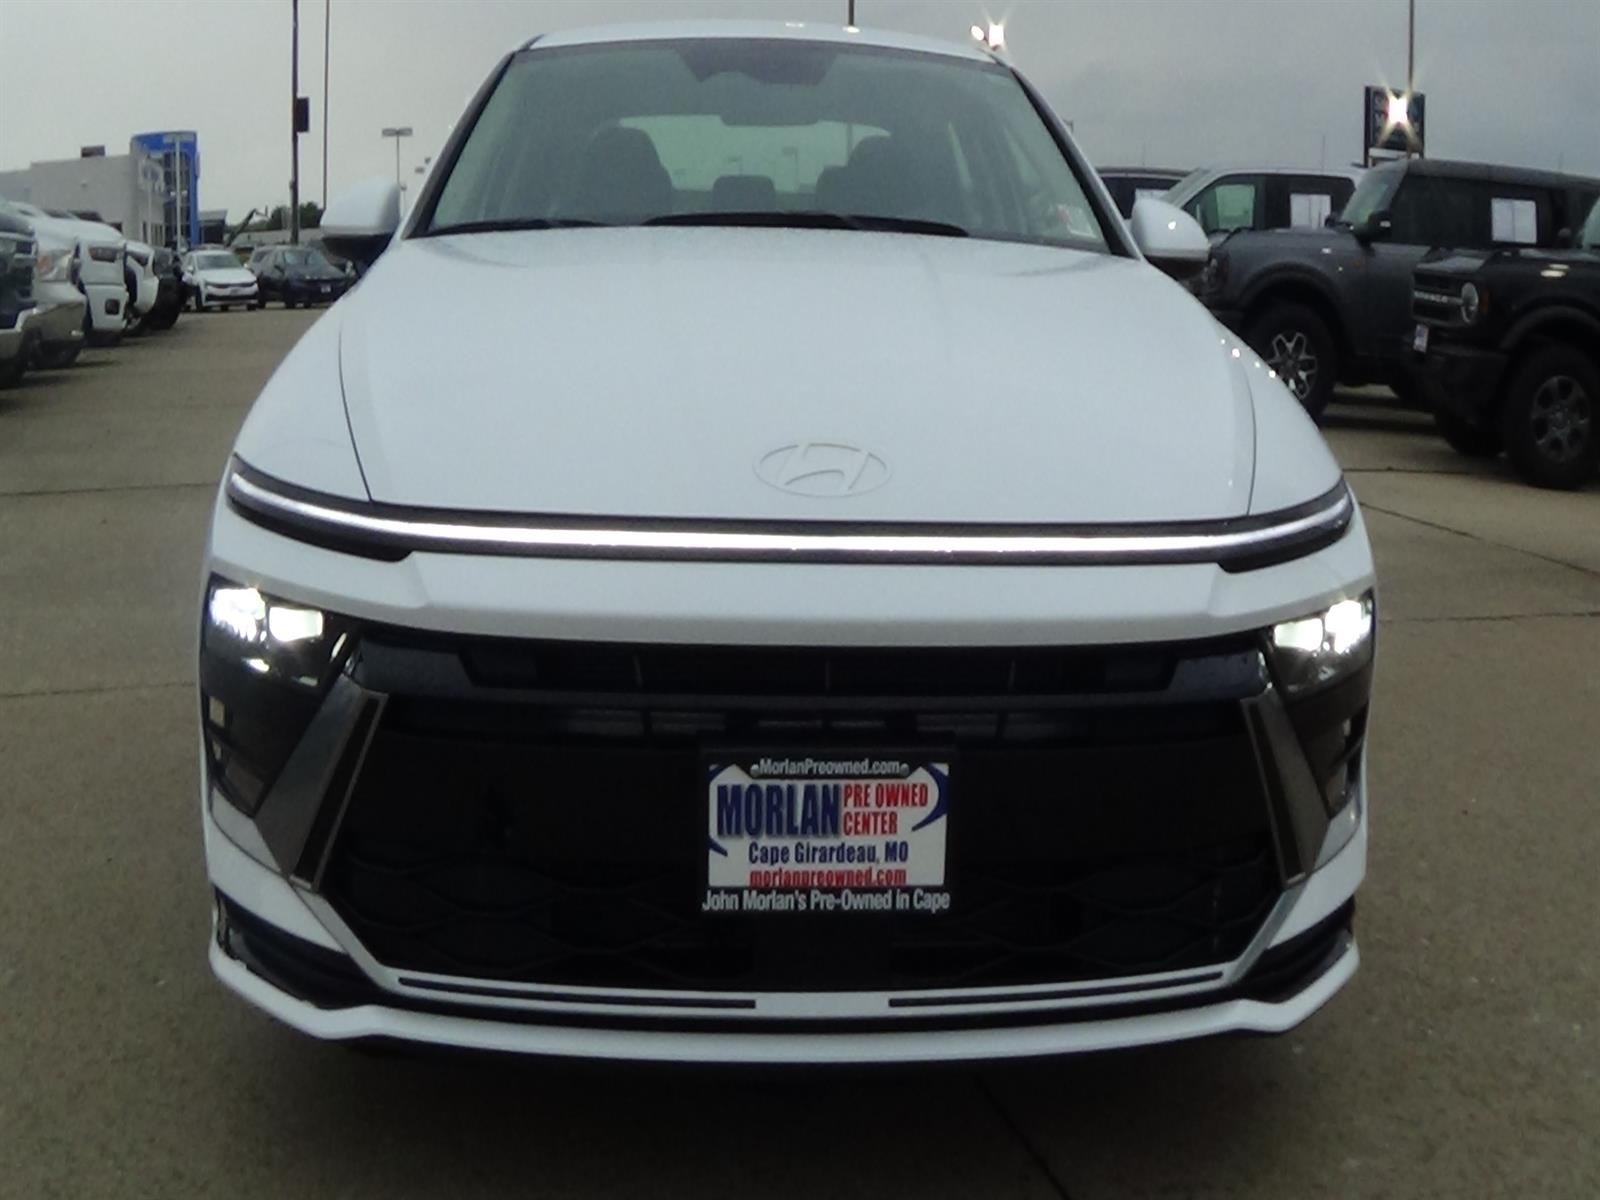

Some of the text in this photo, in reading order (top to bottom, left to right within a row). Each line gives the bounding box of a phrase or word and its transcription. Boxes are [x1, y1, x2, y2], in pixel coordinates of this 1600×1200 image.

[760, 758, 900, 775] MorlanPreowned.com
[844, 783, 928, 808] PRE OWNED
[717, 783, 840, 837] MORLAN
[843, 811, 898, 836] CENTER
[748, 841, 909, 866] Cape Girardeau, MO
[702, 887, 951, 914] John Morlan's Pre-Owned in Cape
